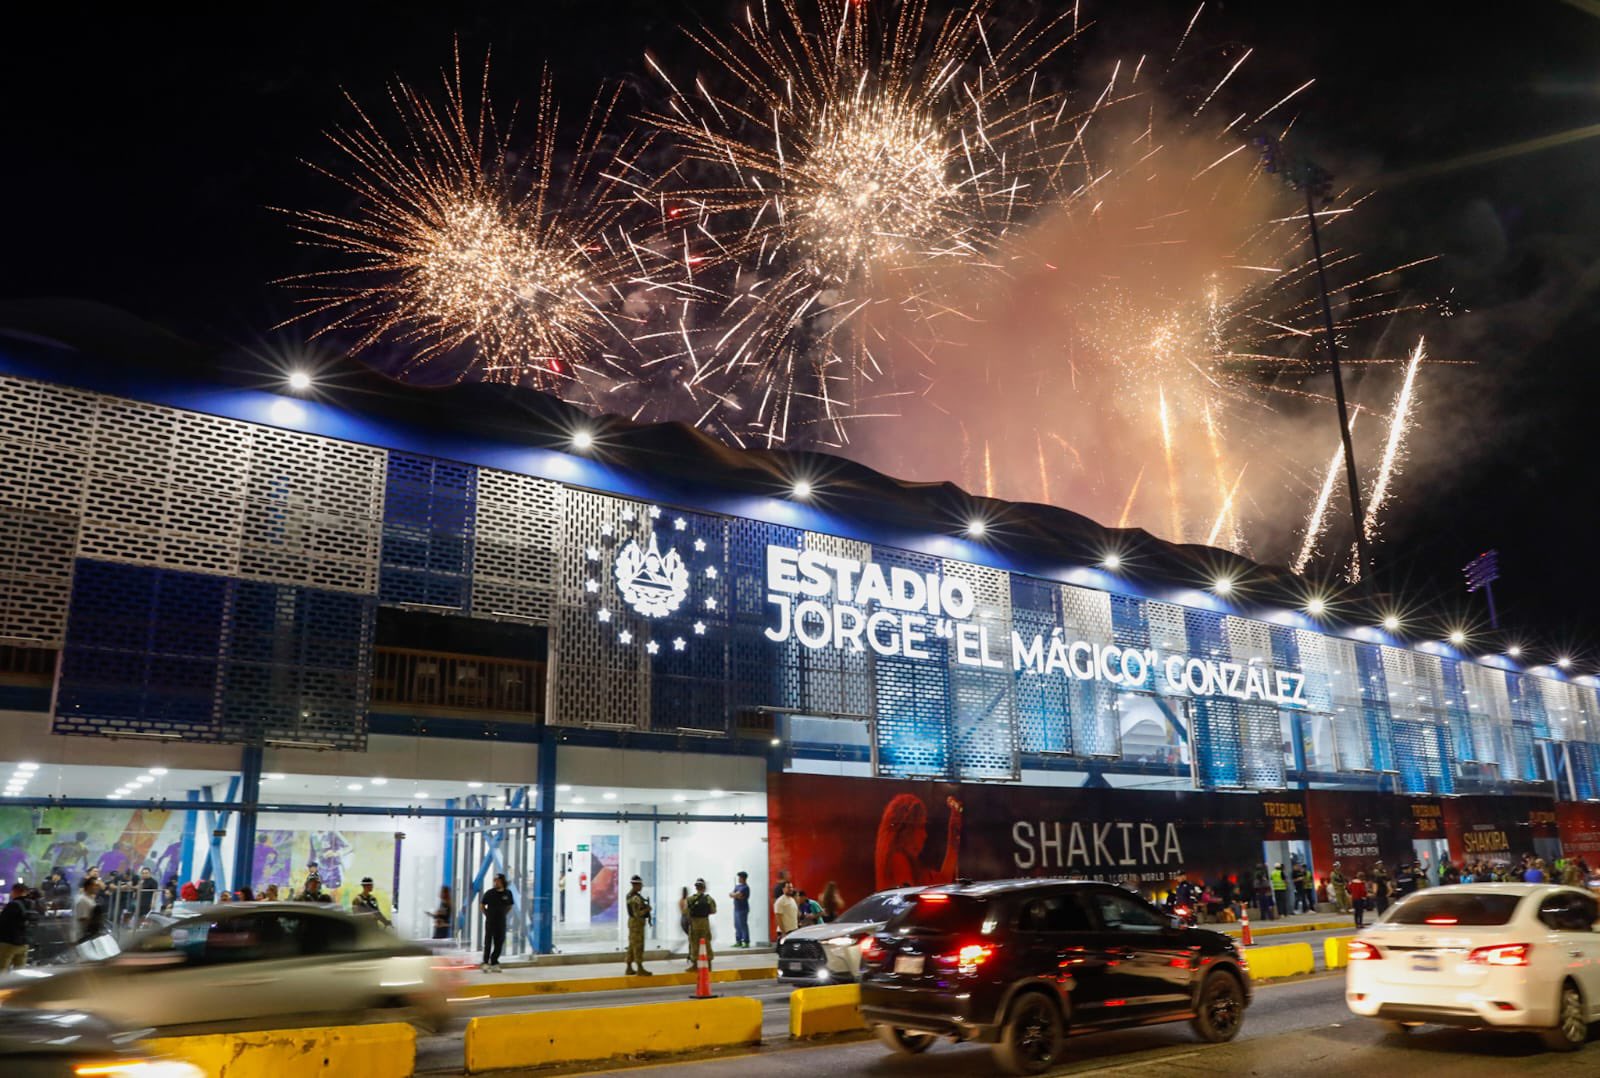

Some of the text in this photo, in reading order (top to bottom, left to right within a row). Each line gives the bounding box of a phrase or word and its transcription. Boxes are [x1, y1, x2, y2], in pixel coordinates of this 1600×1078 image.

[767, 544, 975, 619] ESTADIO
[764, 593, 930, 660] JORGE
[1165, 657, 1308, 705] GONZÁLEZ
[1263, 802, 1304, 817] TRIBUNA
[1273, 818, 1297, 833] ALTA
[1012, 821, 1185, 869] SHAKIRA
[1463, 831, 1510, 852] SHAKIRA
